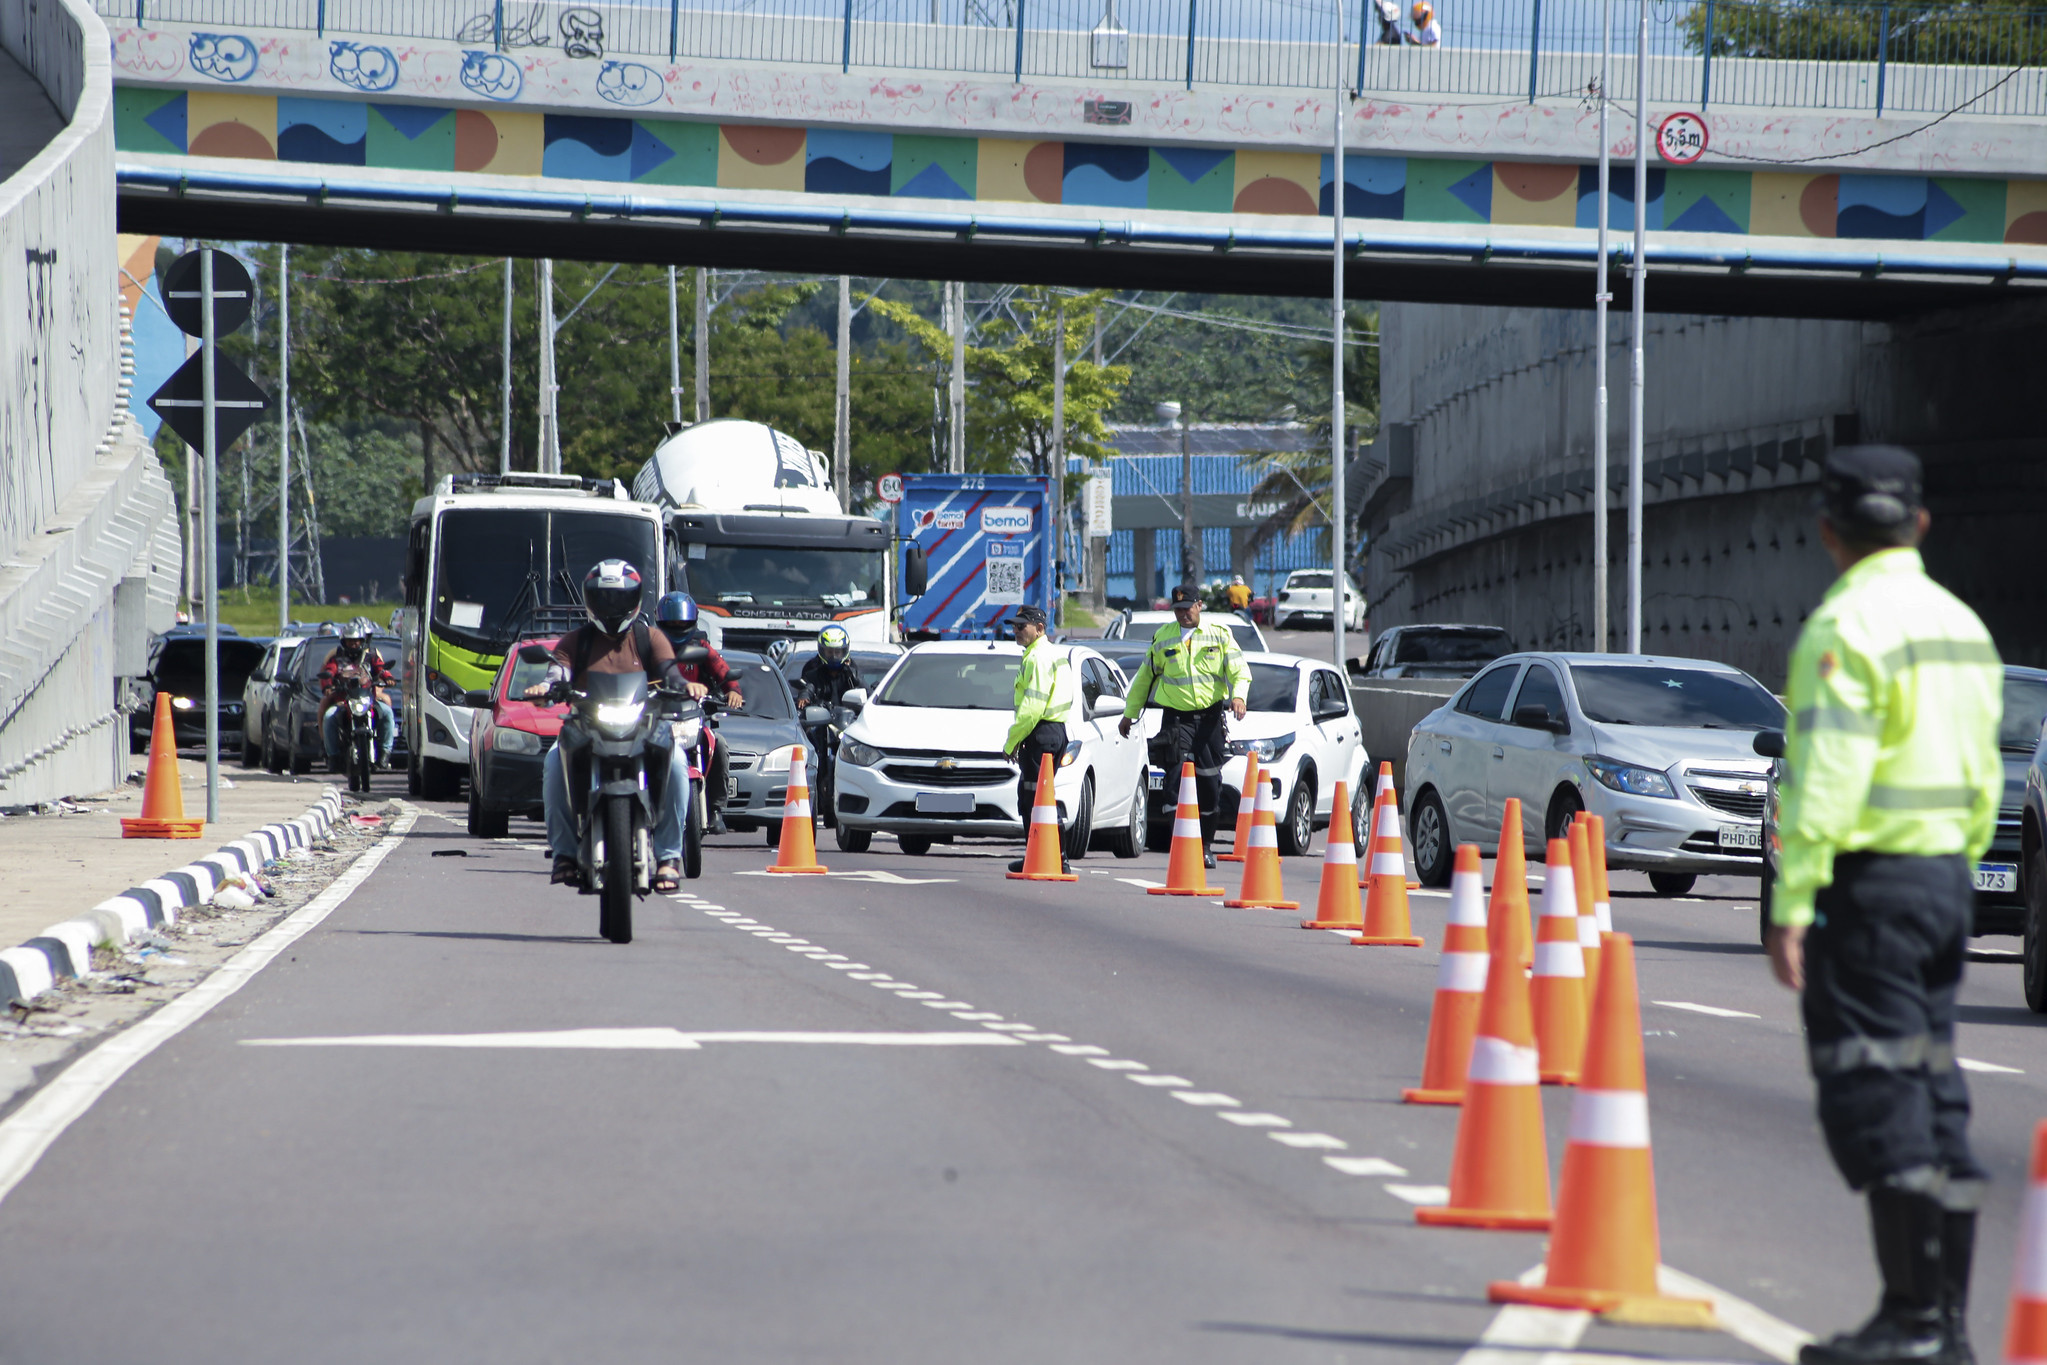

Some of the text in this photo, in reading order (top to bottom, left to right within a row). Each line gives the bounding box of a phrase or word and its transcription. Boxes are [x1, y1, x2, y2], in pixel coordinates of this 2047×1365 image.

[1666, 128, 1699, 151] 5,5m
[882, 479, 901, 492] 60
[985, 514, 1028, 526] bemol
[734, 609, 831, 620] CONSTELLATION
